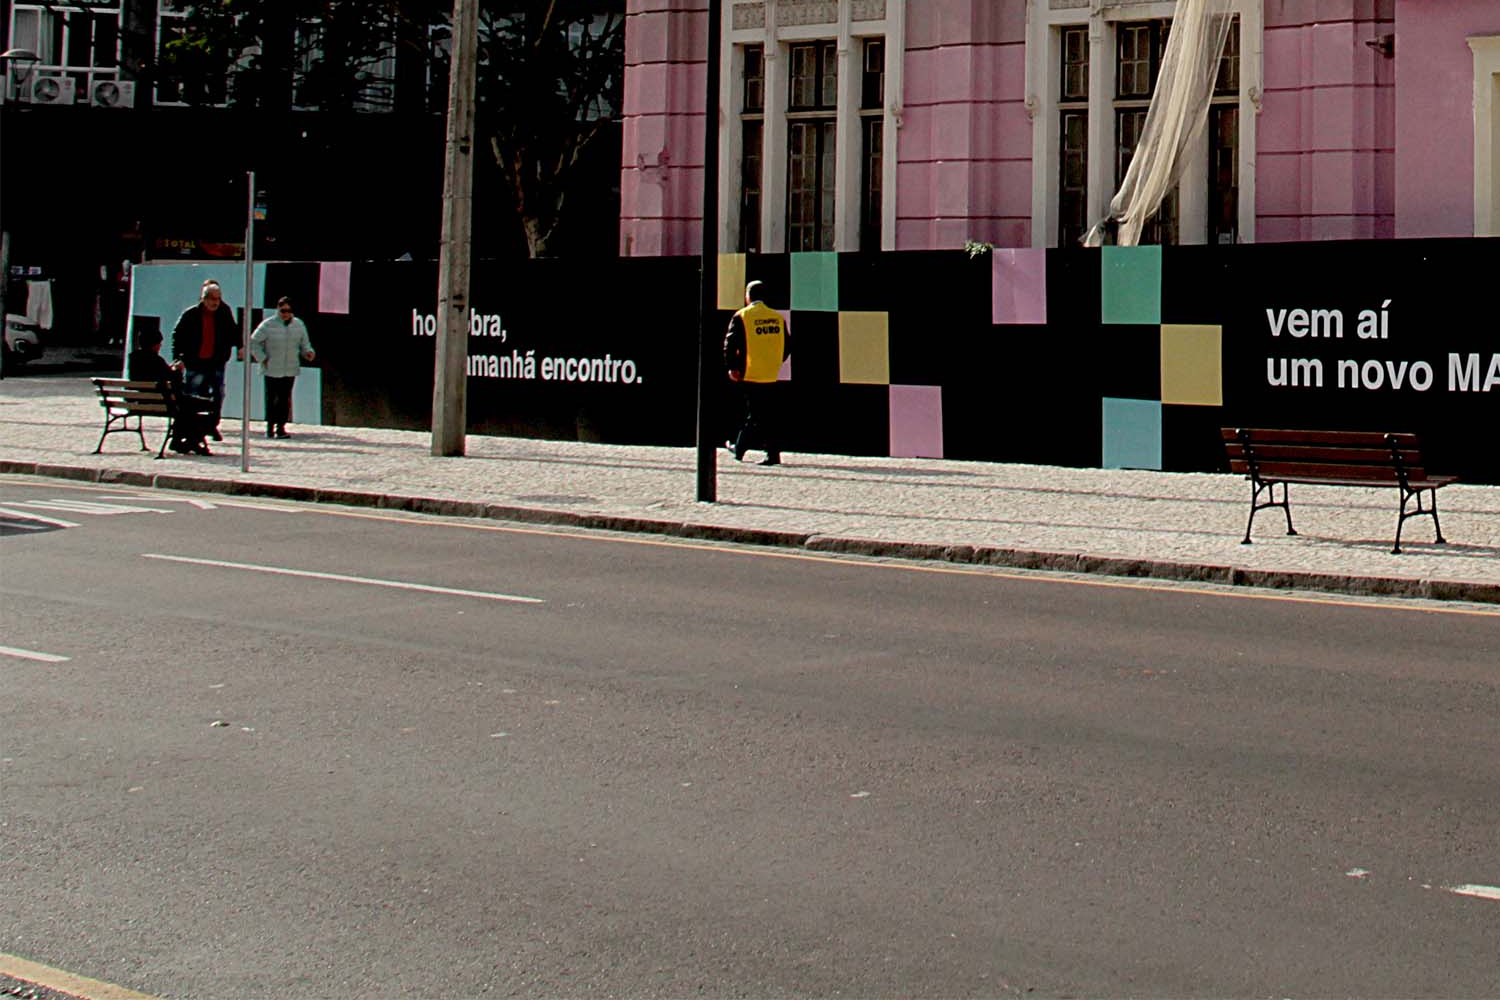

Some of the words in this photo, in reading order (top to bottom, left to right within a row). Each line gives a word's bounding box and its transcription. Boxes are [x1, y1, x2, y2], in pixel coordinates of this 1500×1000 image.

[467, 308, 507, 343] bra,
[755, 326, 781, 335] OURO
[1266, 308, 1343, 338] vem
[1357, 299, 1392, 339] aí
[541, 353, 643, 384] encontro.
[1267, 357, 1323, 387] um
[1338, 359, 1433, 391] novo
